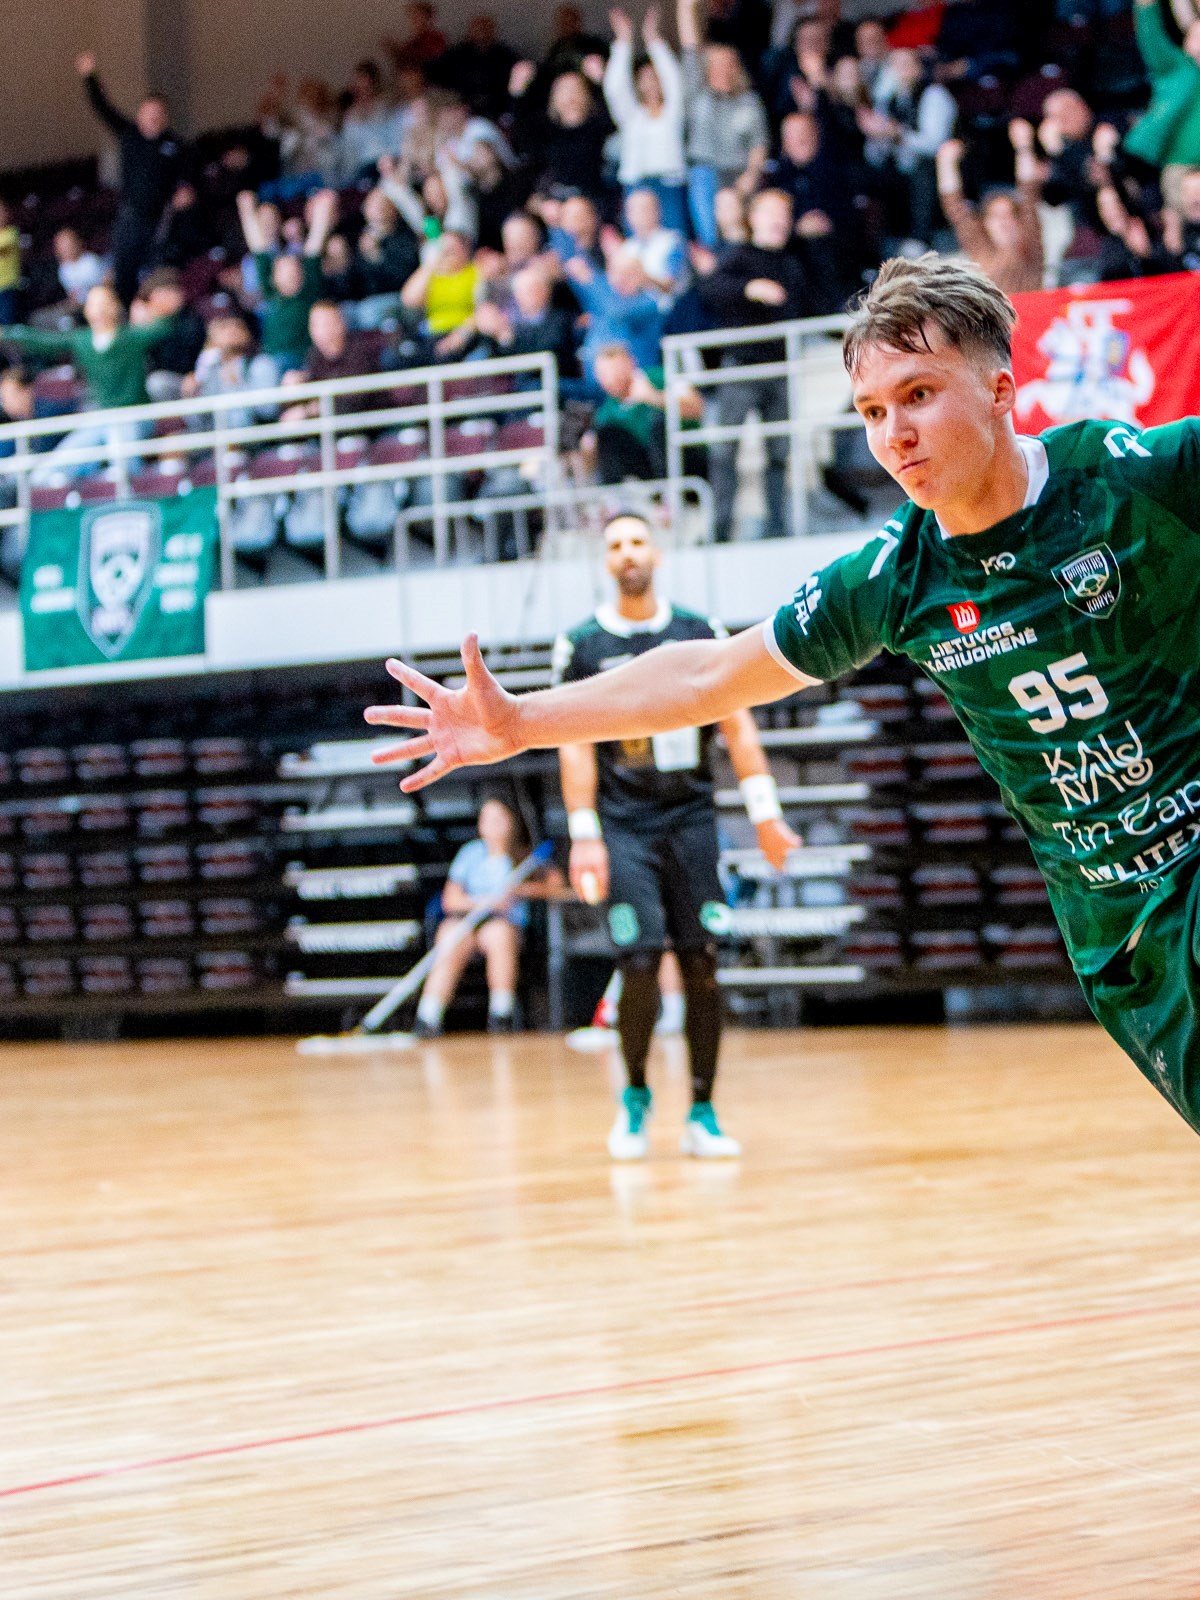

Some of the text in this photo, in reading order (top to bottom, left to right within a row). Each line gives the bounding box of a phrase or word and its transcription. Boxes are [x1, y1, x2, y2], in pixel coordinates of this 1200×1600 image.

[923, 626, 1038, 673] KARIUOMENĖ
[929, 620, 1015, 659] LIETUVOS
[1008, 651, 1109, 734] 95
[1051, 820, 1115, 855] Tin
